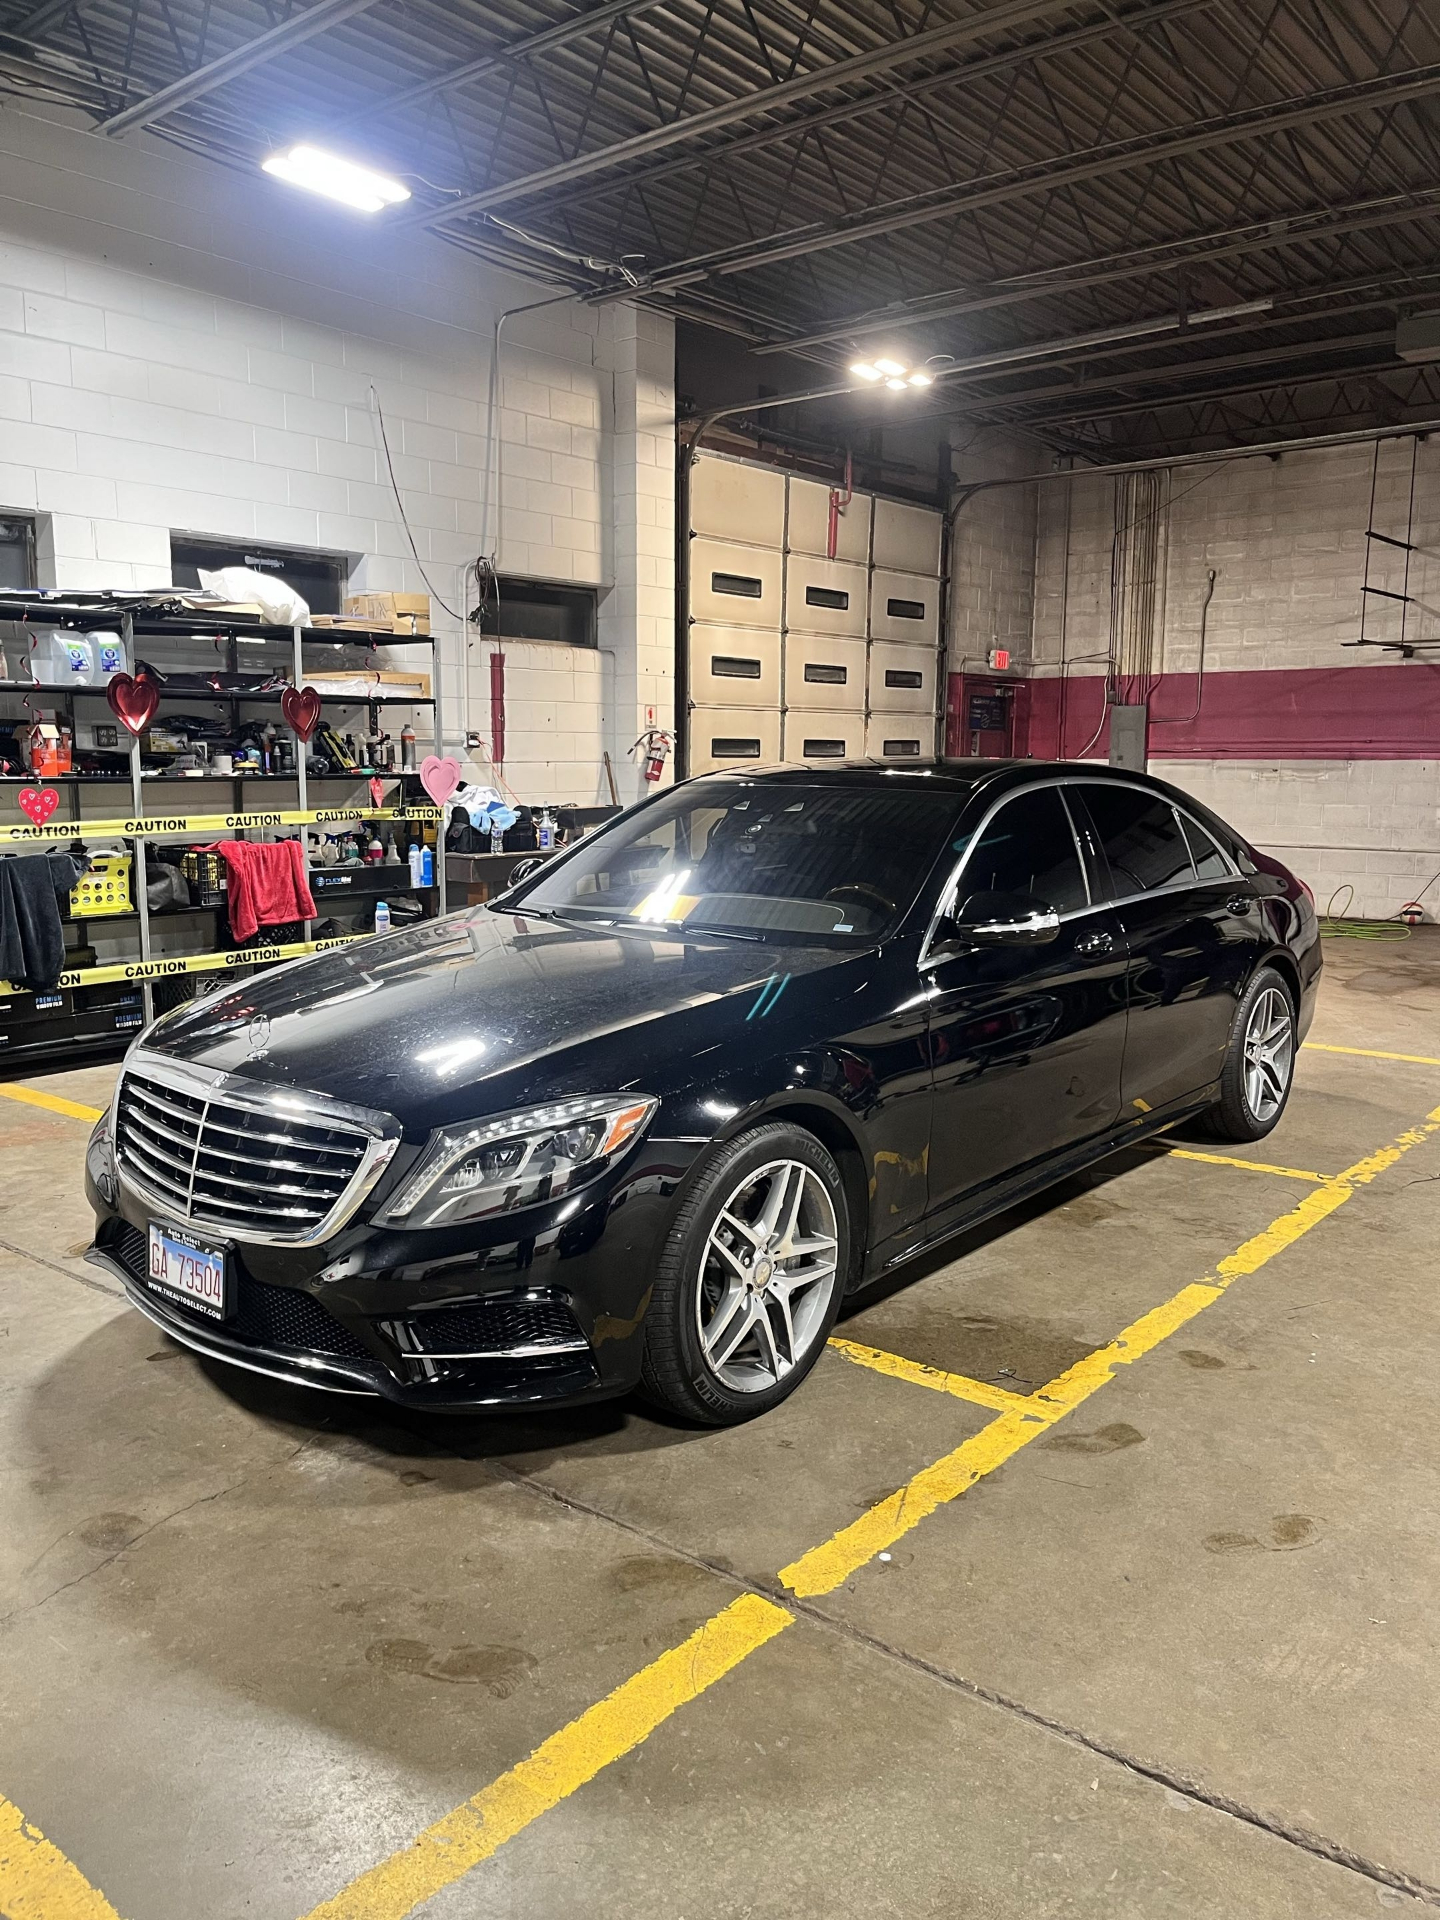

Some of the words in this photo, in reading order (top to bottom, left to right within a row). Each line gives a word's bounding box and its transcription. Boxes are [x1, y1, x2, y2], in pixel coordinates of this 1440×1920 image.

[9, 825, 80, 839] CAUTION
[125, 819, 187, 832] CAUTION
[226, 814, 281, 827] CAUTION
[316, 810, 363, 822] CAUTION
[125, 961, 187, 977] CAUTION
[226, 949, 280, 964] CAUTION
[35, 995, 62, 1004] PREMIUM
[115, 1013, 142, 1022] PREMIUM
[795, 1138, 839, 1183] MICHELIN
[152, 1243, 167, 1279] GA
[178, 1253, 221, 1301] 73504
